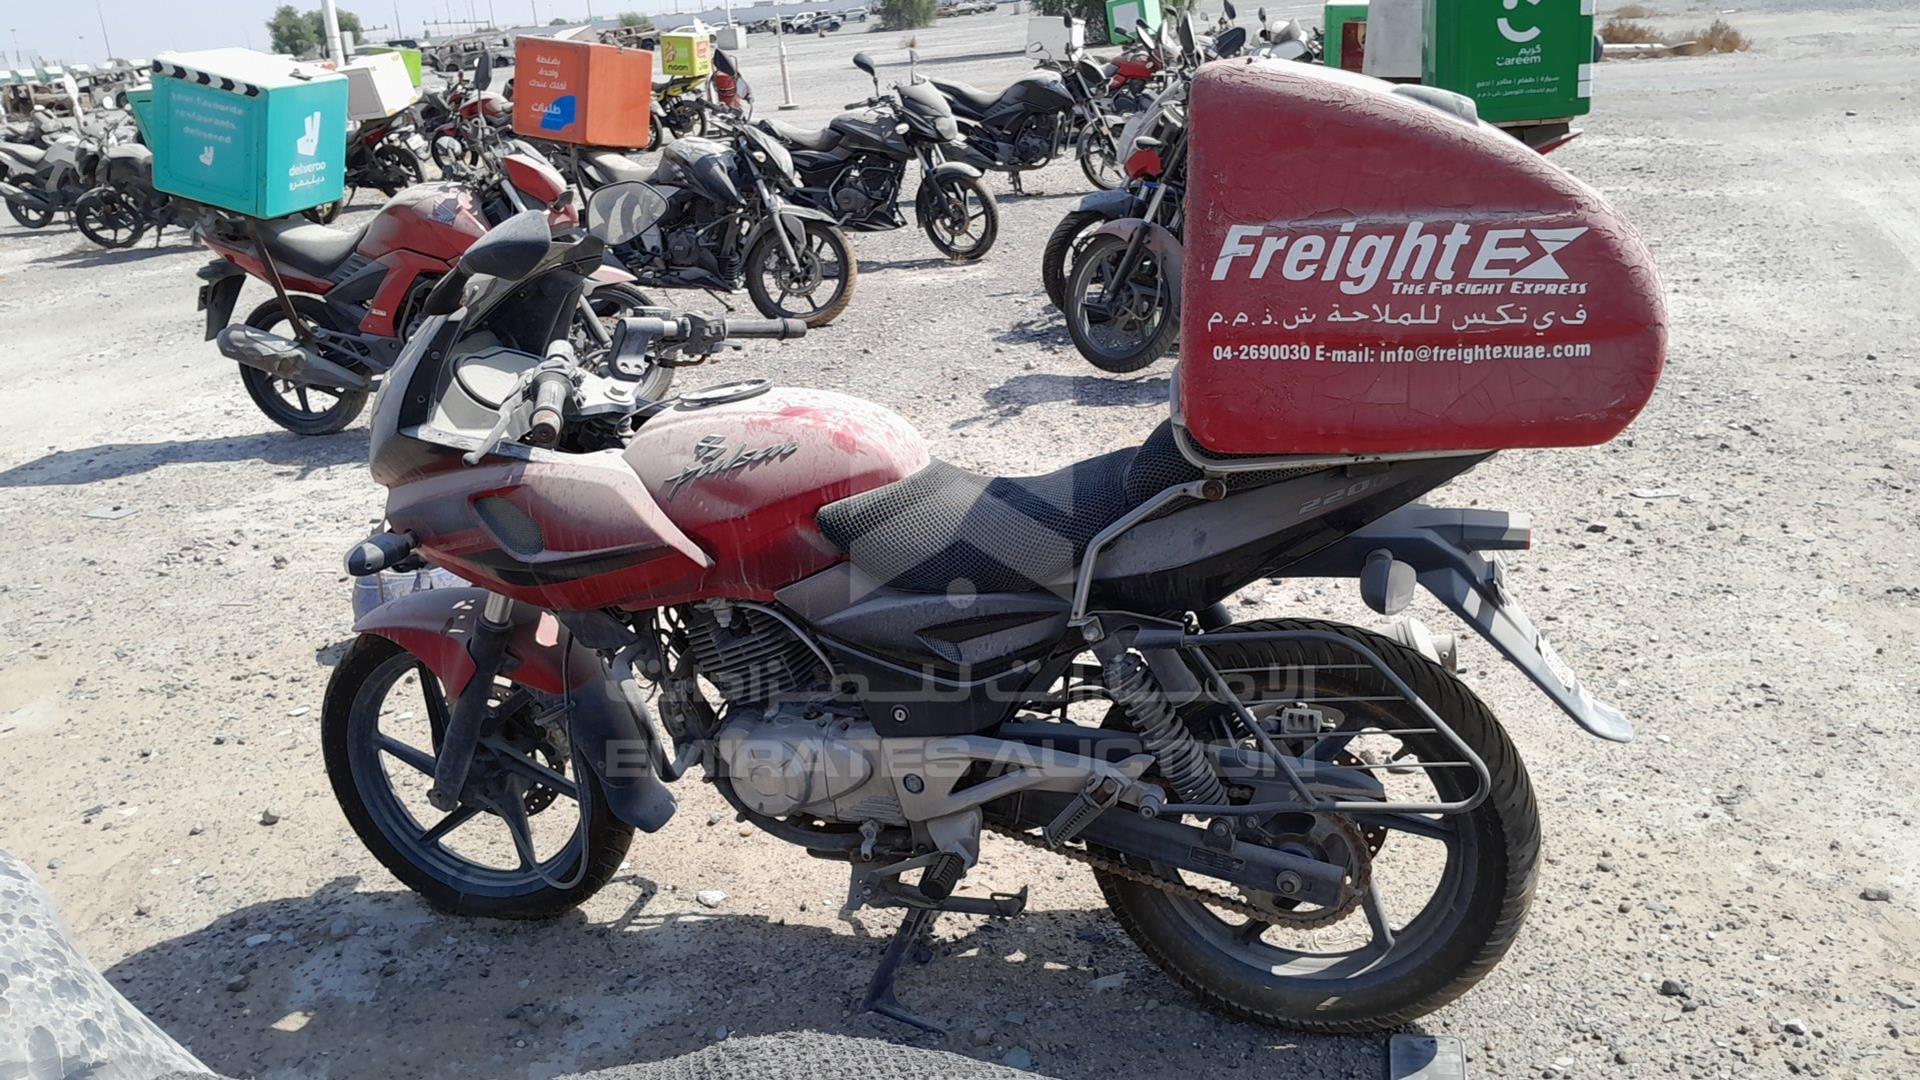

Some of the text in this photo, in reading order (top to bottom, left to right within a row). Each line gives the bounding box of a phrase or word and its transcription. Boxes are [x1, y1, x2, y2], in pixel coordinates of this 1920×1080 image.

[531, 102, 561, 115] طلبات
[288, 161, 327, 176] deliveroo
[1391, 281, 1426, 295] THE
[1509, 281, 1589, 295] EXPRESS
[1326, 303, 1442, 327] للملاحة
[1212, 342, 1592, 364] 04-2690030 E-mail: info@freightexuae.com
